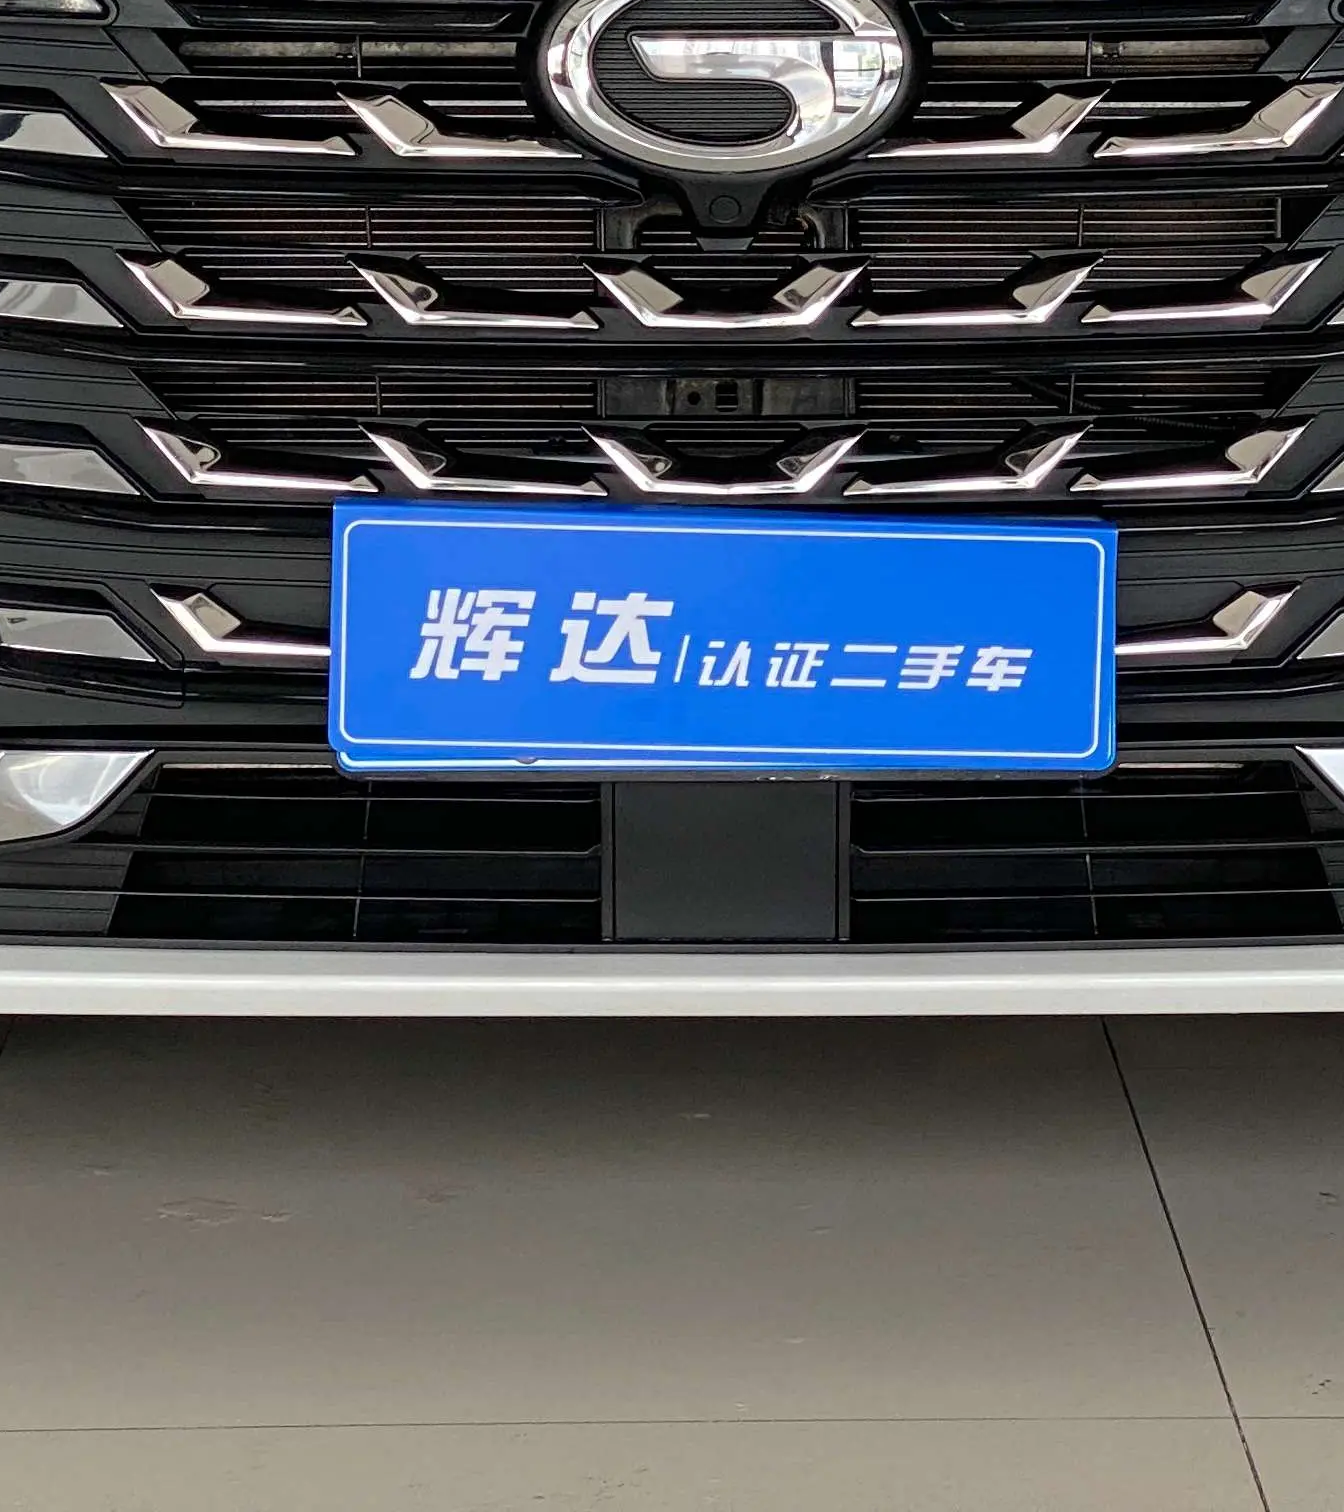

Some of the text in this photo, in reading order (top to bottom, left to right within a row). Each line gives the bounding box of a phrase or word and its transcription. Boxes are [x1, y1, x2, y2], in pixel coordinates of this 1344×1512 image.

[410, 589, 1033, 692] 辉达 认证二手车
